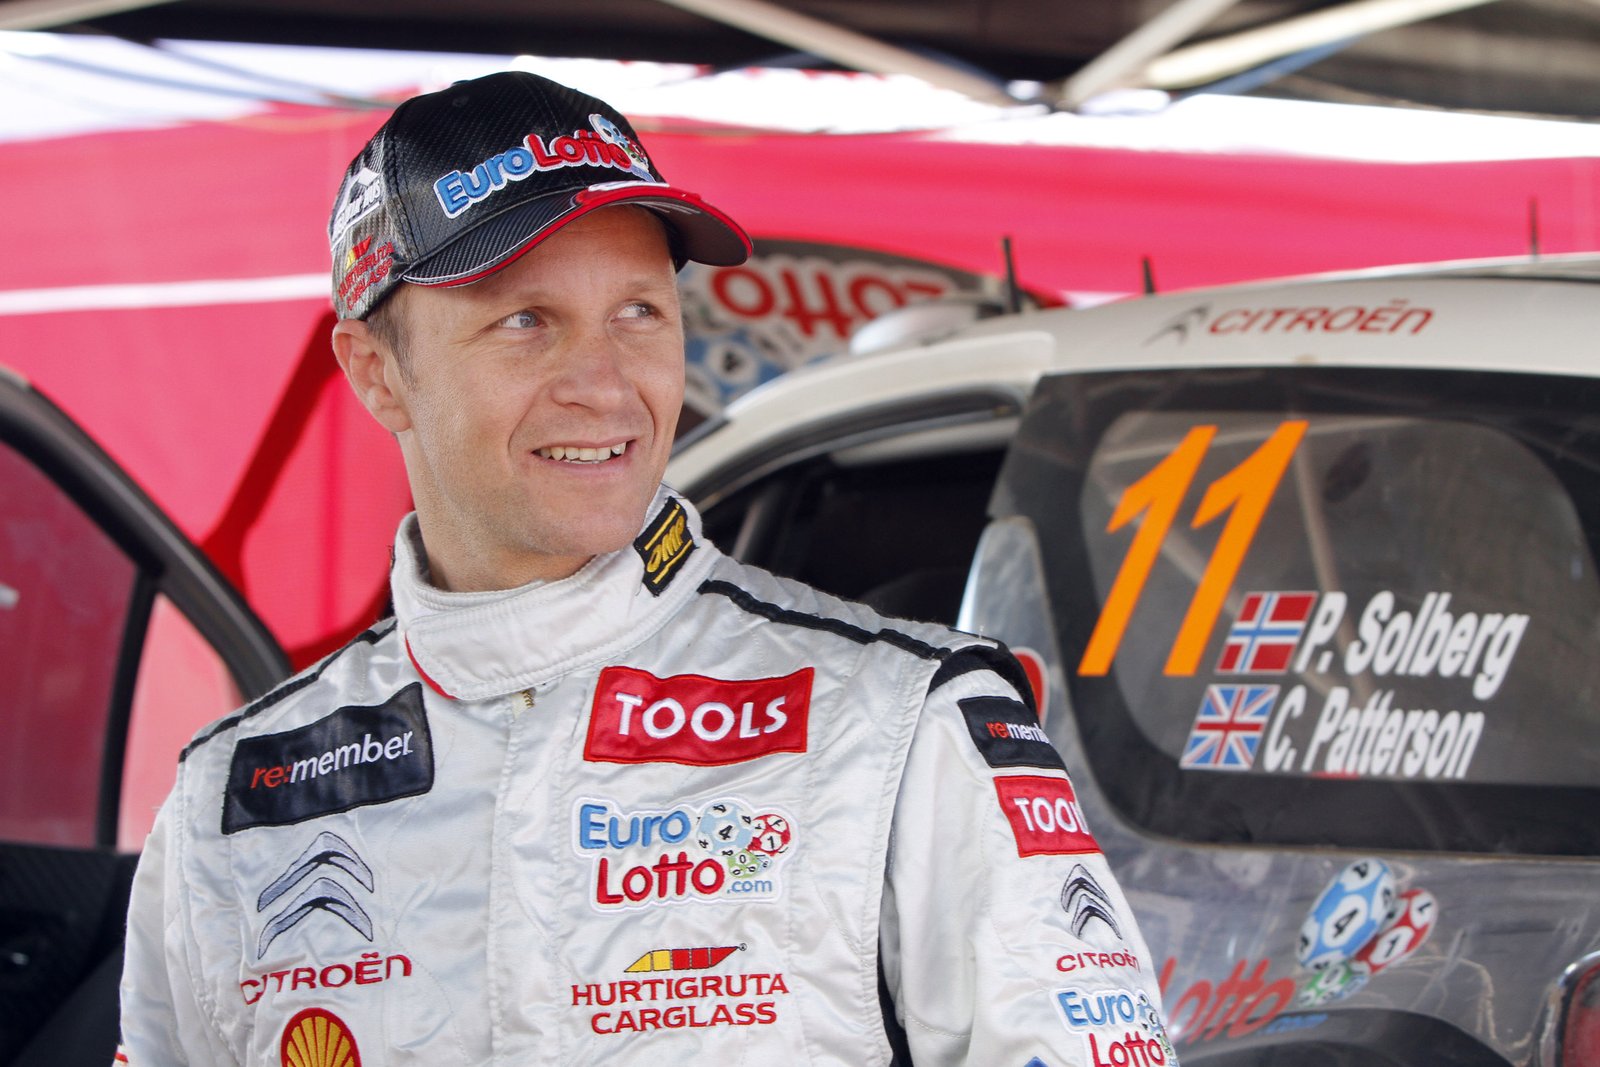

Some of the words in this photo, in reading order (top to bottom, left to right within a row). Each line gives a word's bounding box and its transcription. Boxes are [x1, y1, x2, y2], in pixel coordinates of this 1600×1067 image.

[1076, 420, 1310, 677] 11
[1294, 591, 1348, 674] P.
[1344, 591, 1530, 700] Solberg
[615, 692, 788, 742] TOOLS
[1263, 685, 1307, 773] C.
[1301, 686, 1485, 780] Patterson
[250, 730, 414, 790] re:member
[578, 803, 692, 849] Euro
[1013, 797, 1090, 835] TOOL
[596, 851, 725, 905] Lotto
[726, 880, 773, 894] .com
[571, 973, 791, 1007] HURTIGRUTA
[1057, 991, 1135, 1027] Euro
[591, 1002, 778, 1035] CARGLASS
